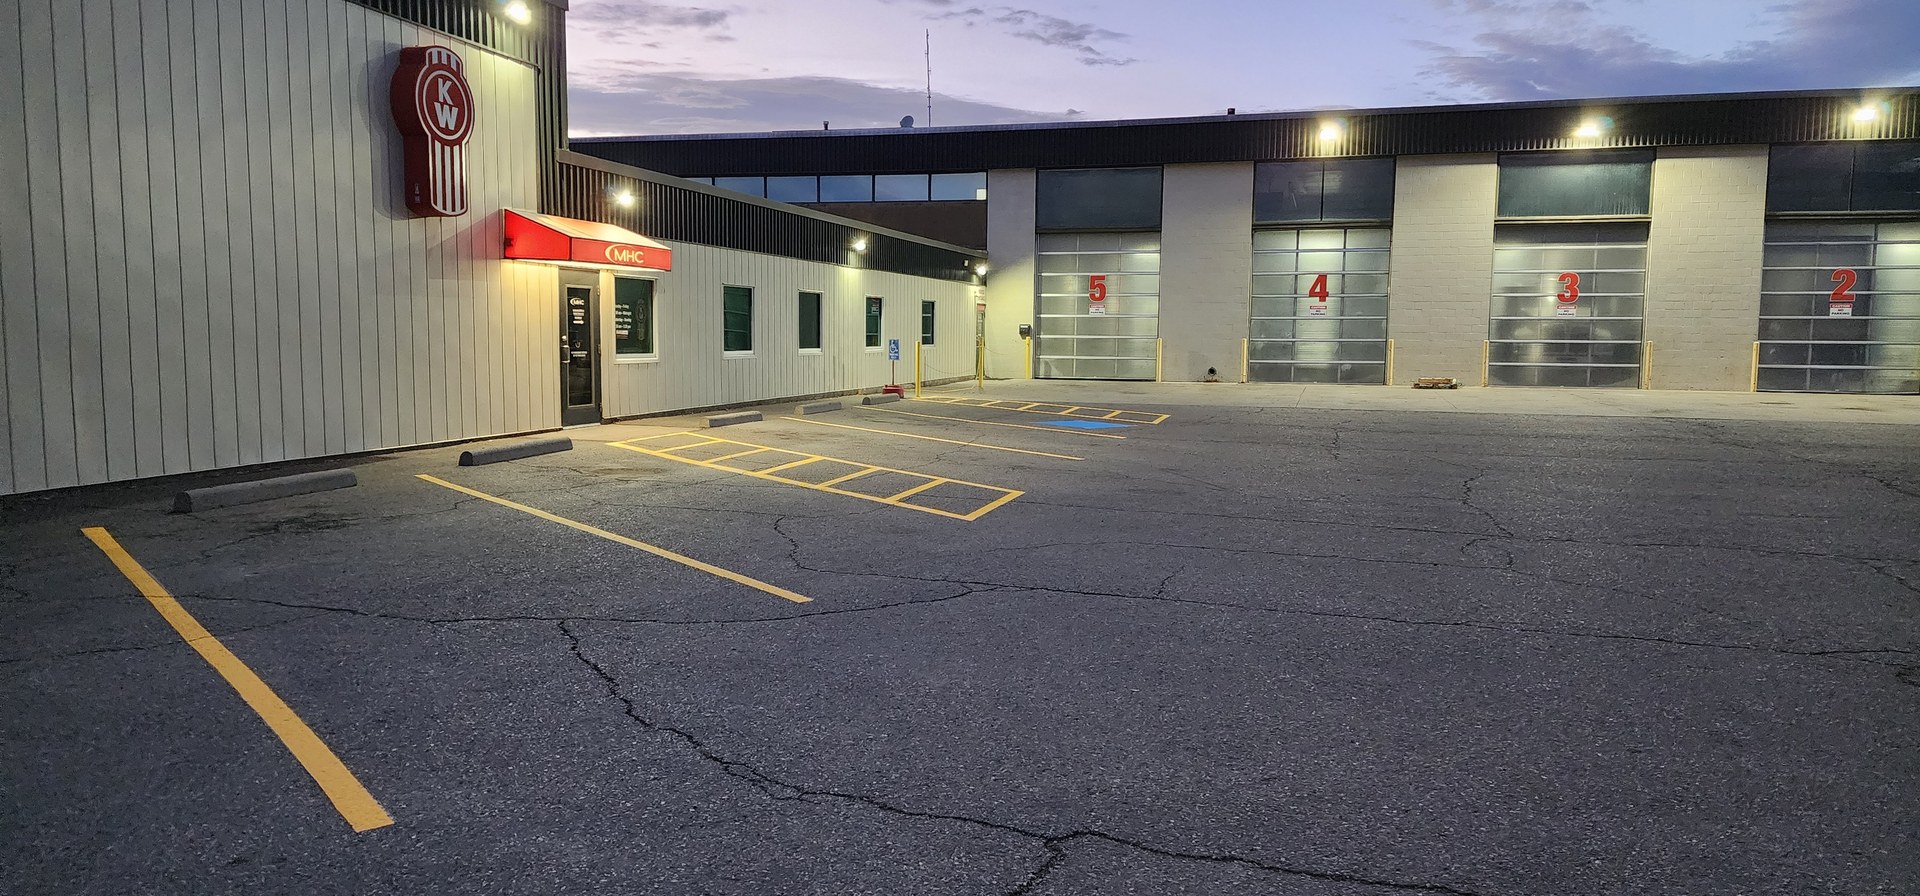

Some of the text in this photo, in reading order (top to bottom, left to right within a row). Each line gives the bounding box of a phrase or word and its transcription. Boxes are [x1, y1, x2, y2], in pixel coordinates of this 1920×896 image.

[437, 77, 454, 106] K
[433, 101, 459, 131] W
[614, 248, 644, 264] MHC
[1088, 274, 1107, 303] 5
[1308, 273, 1329, 303] 4
[1556, 272, 1580, 303] 3
[1830, 268, 1856, 302] 2
